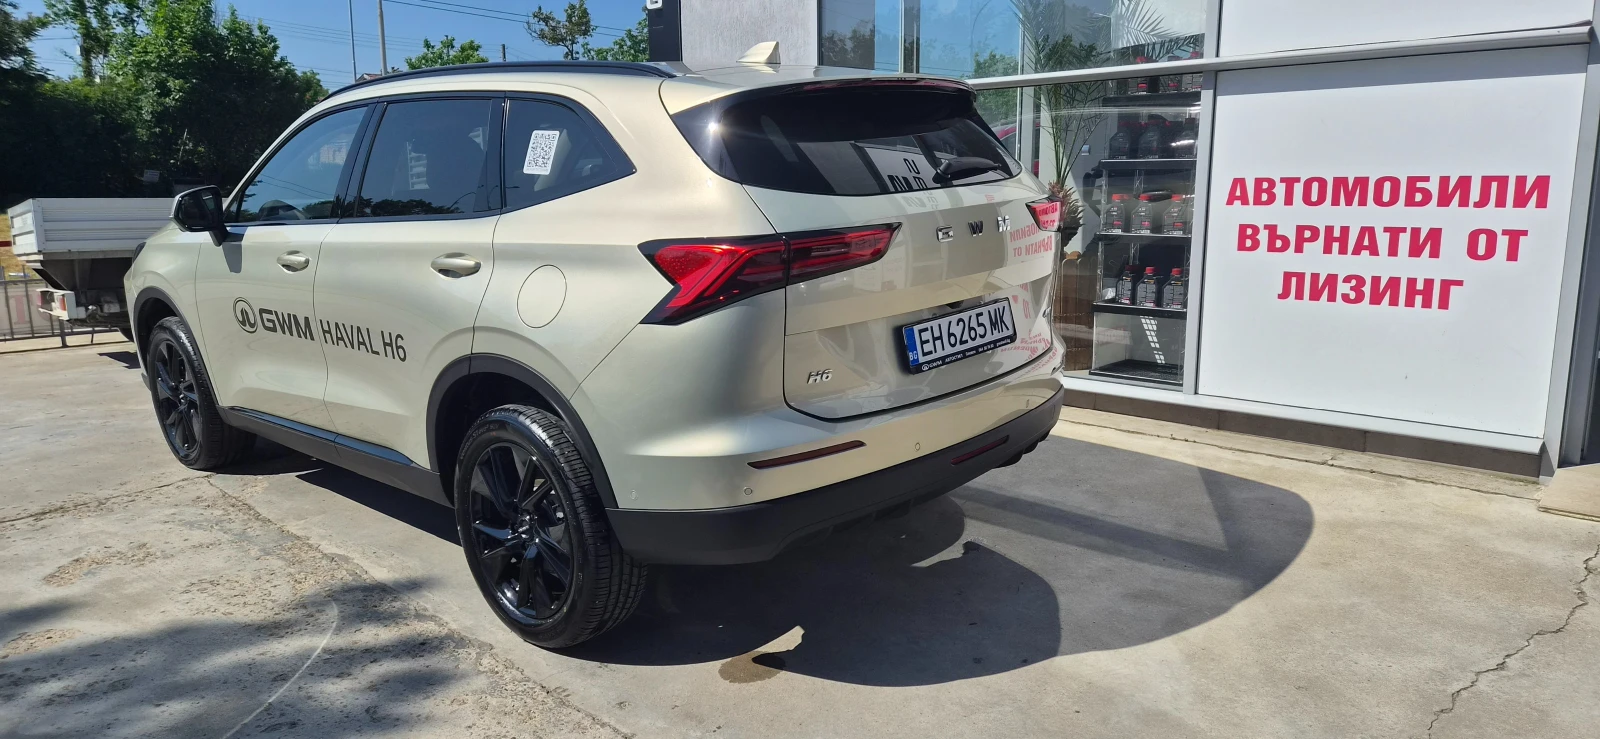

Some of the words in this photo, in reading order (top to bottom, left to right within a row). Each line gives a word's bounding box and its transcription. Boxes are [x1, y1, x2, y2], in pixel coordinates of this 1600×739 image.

[1225, 175, 1551, 209] АВТОМОБИЛИ
[1236, 223, 1443, 259] ВЪРНАТИ
[1466, 228, 1529, 262] ОТ
[1277, 271, 1464, 310] ЛИЗИНГ
[258, 308, 315, 341] GWM
[319, 319, 380, 356] HAVAL
[381, 330, 407, 362] H6
[918, 323, 945, 357] EH
[947, 312, 987, 348] 6265
[988, 306, 1010, 335] MK
[807, 368, 833, 385] H6
